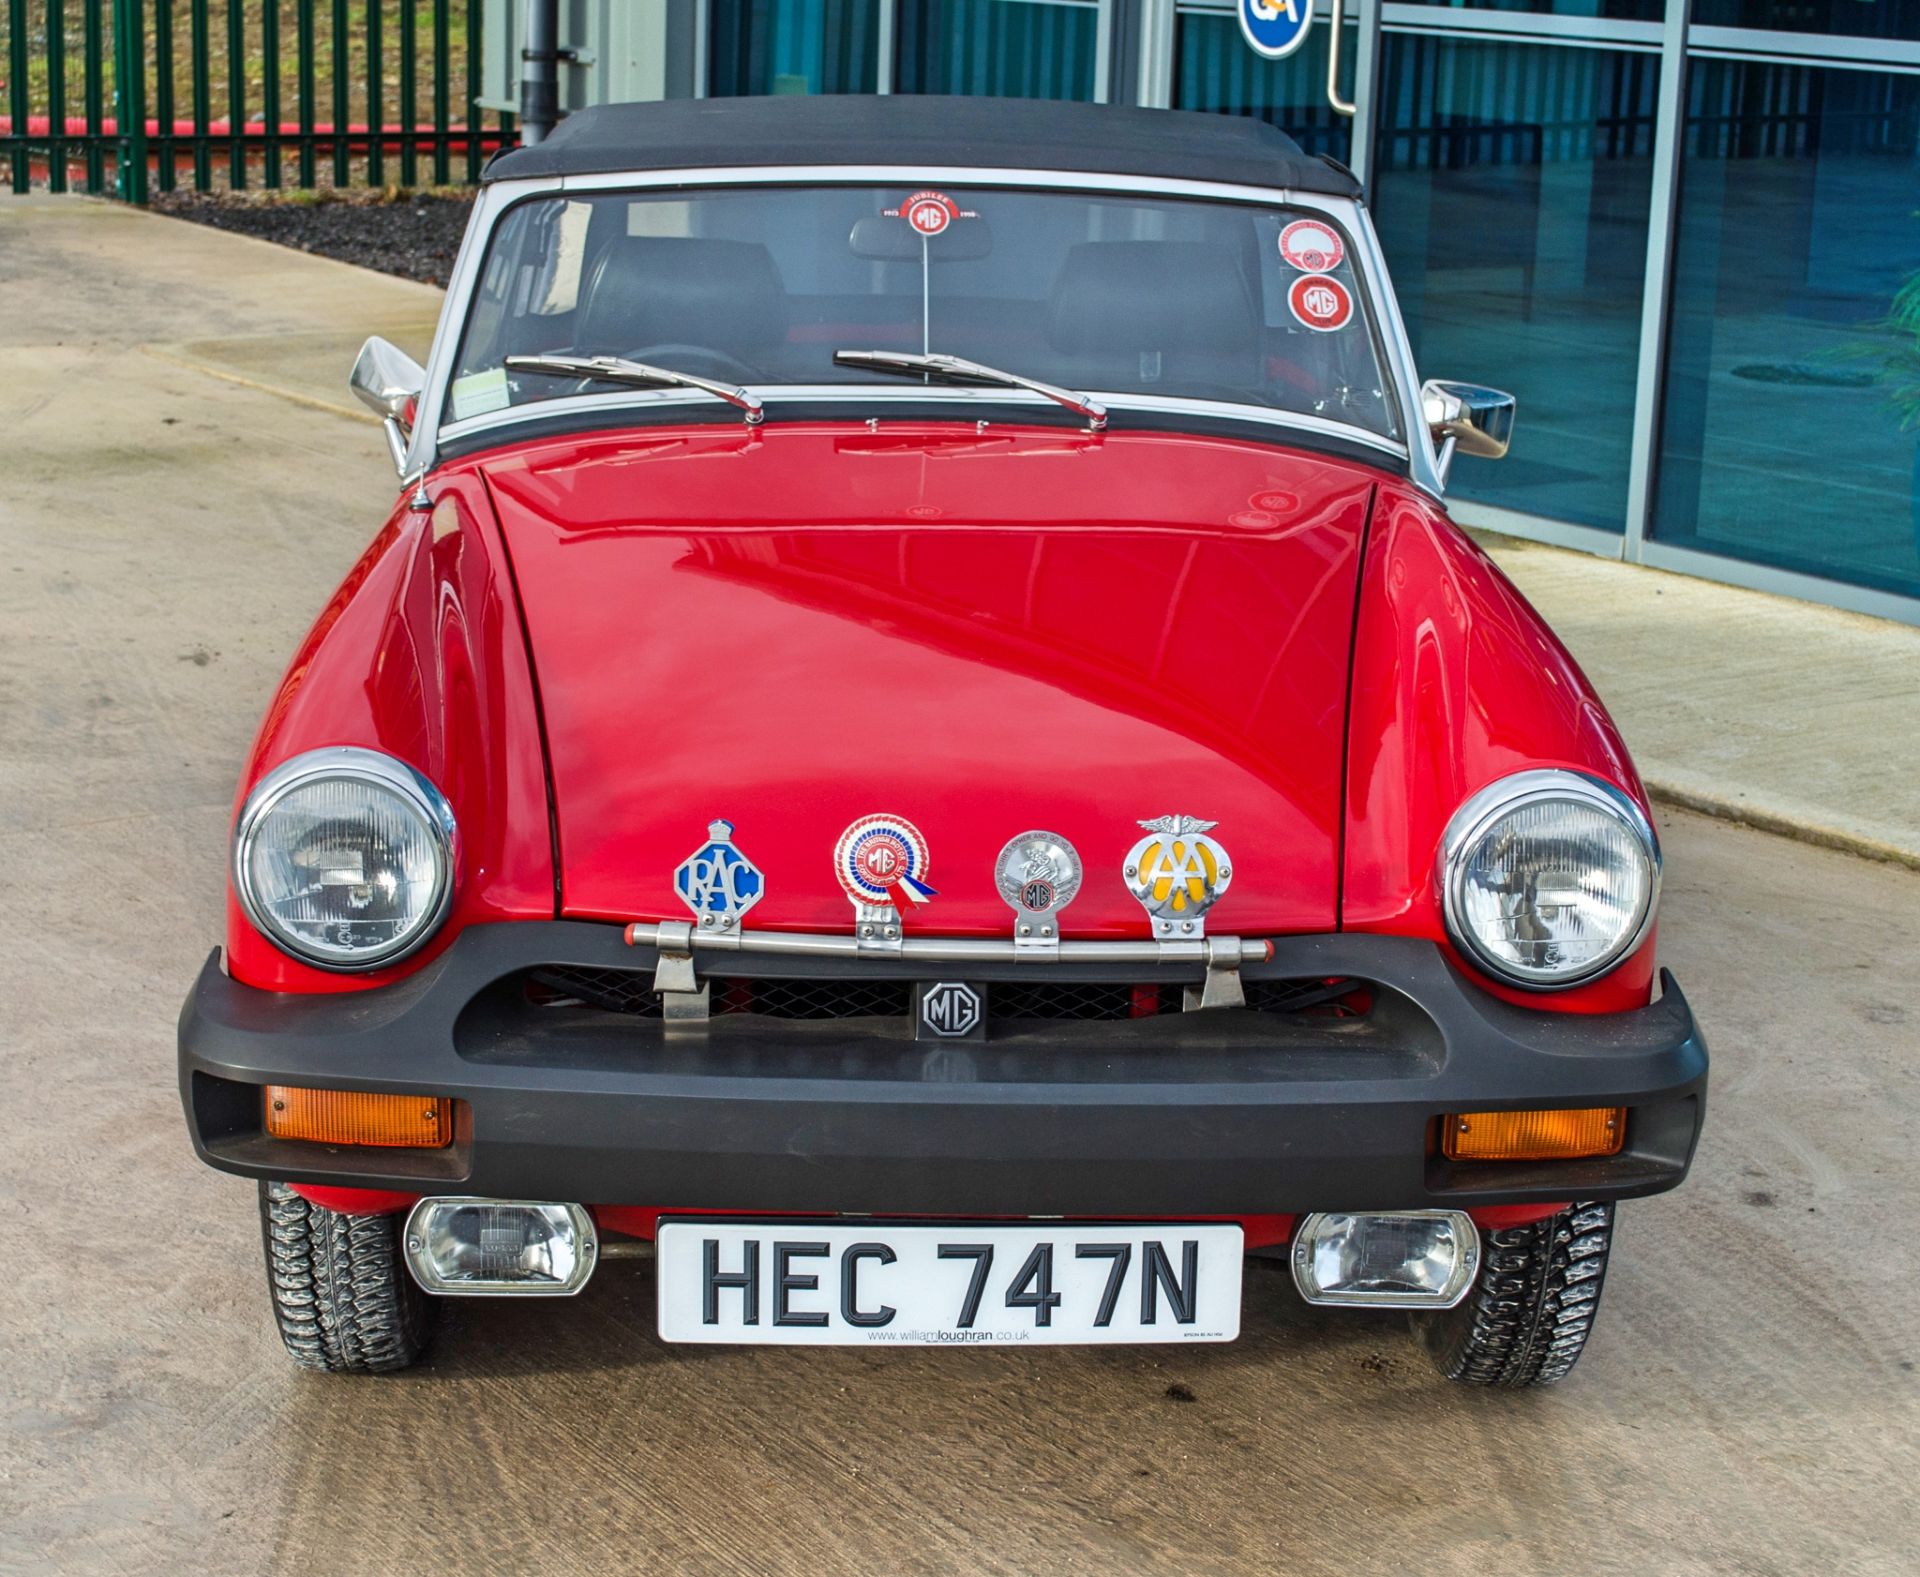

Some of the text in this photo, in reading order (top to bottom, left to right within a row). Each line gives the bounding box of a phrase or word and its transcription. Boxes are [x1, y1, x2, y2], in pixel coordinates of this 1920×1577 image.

[909, 192, 949, 204] JUBILEE
[917, 208, 942, 229] MG
[1308, 289, 1336, 315] MG
[868, 848, 896, 873] MG
[889, 838, 908, 860] MOTOR
[687, 849, 752, 911] RAC
[1143, 839, 1214, 908] AA
[1026, 884, 1050, 908] MG
[931, 990, 973, 1030] MG
[703, 1239, 1199, 1328] HEC 747N
[868, 1330, 1030, 1343] www.williamloughran.co.uk
